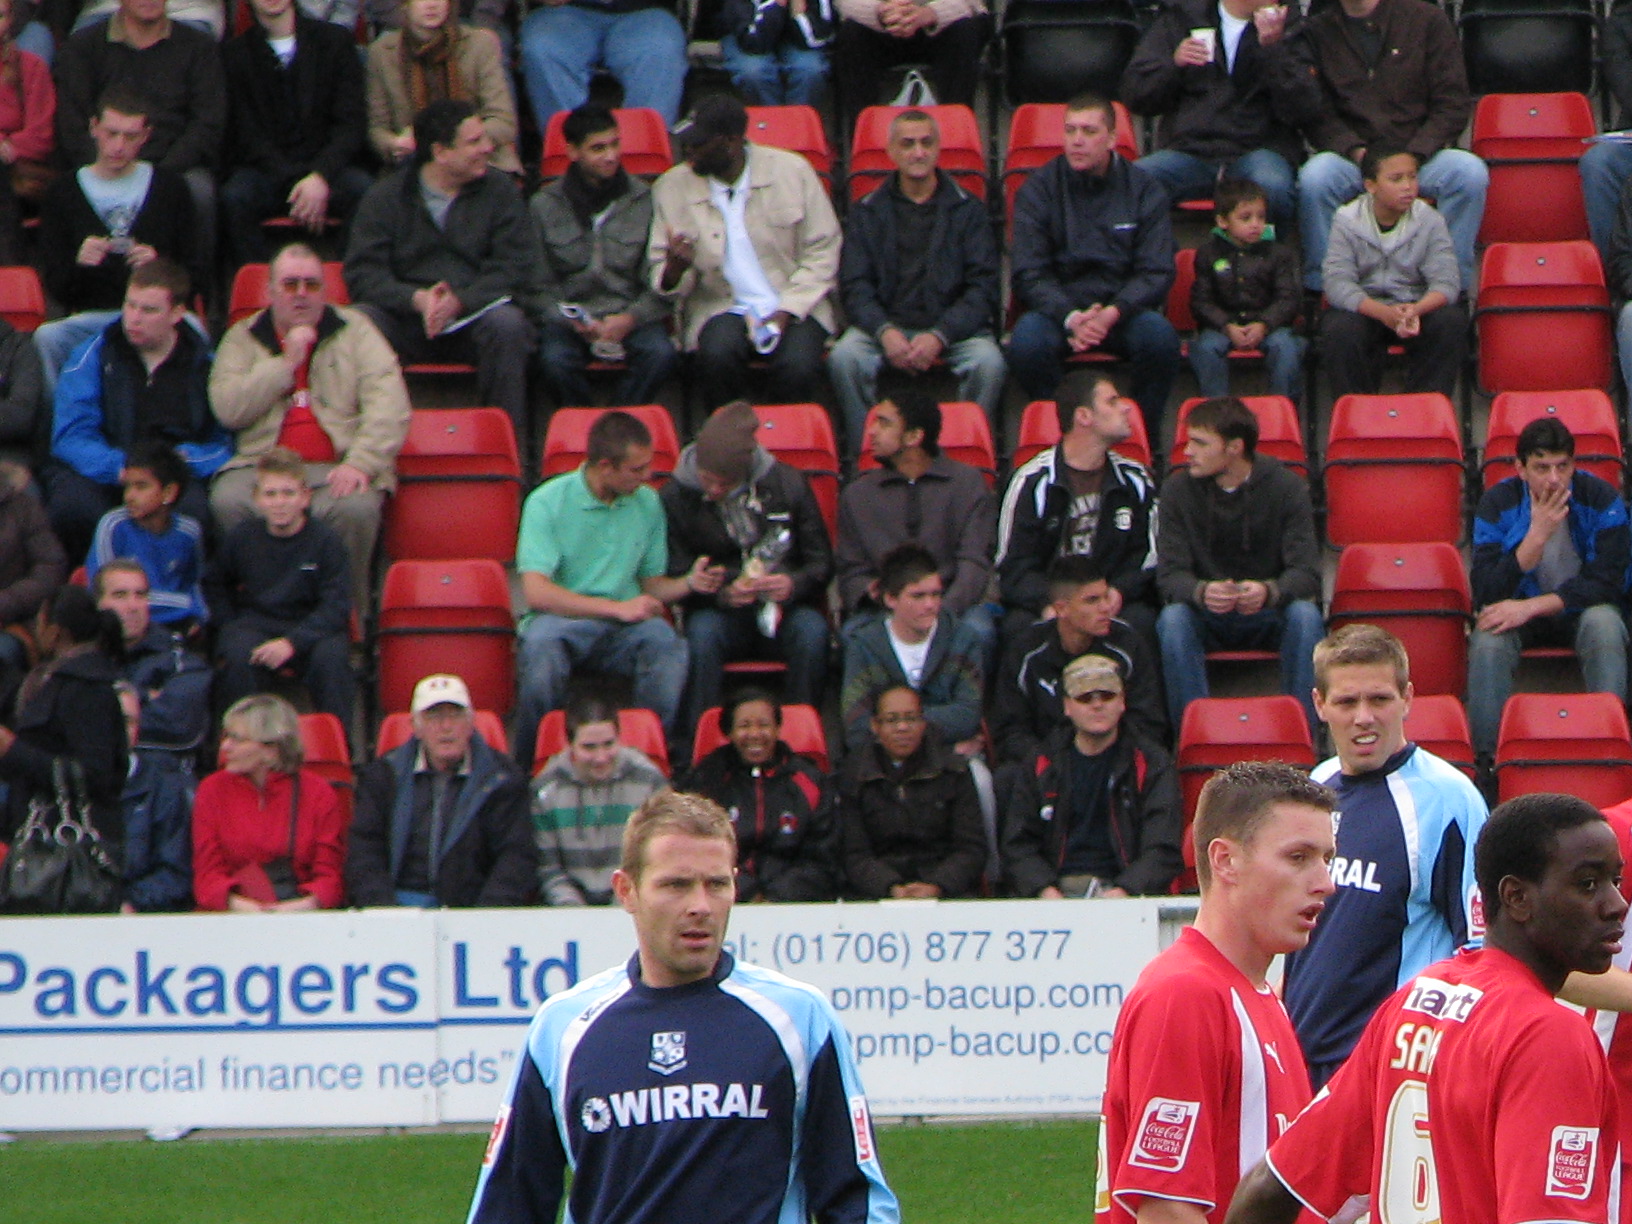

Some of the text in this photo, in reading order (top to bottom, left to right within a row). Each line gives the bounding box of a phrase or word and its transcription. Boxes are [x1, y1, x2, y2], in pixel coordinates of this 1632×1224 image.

[772, 932, 910, 969] (01706)
[925, 930, 992, 962] 877
[1005, 929, 1072, 961] 377
[0, 941, 578, 1029] Packagers Ltd
[831, 978, 1124, 1018] pmp-bacup.com
[852, 1024, 1114, 1065] pmp-bacup.co
[1389, 1022, 1444, 1076] SA
[0, 1056, 206, 1095] ommercial
[220, 1055, 363, 1091] finance
[609, 1083, 769, 1128] WIRRAL
